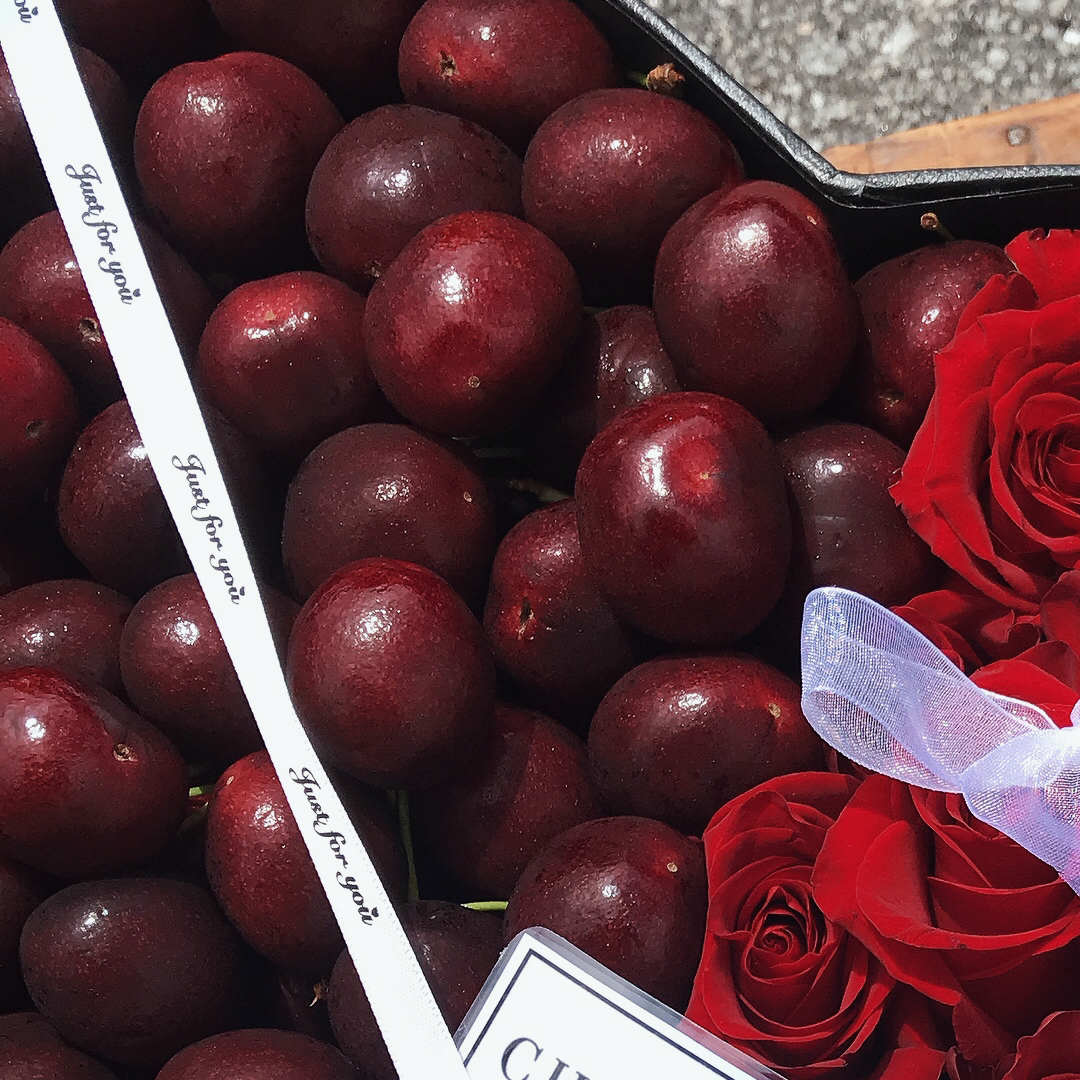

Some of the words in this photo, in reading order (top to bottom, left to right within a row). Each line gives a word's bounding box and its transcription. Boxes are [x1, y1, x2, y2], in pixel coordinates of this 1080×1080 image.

[65, 163, 103, 216] Just
[81, 211, 118, 256] for
[98, 256, 142, 305] you
[171, 454, 211, 509] Just
[190, 505, 223, 551] for
[209, 554, 245, 605] you
[289, 767, 330, 825] Just
[313, 820, 348, 869] for
[336, 871, 379, 926] you
